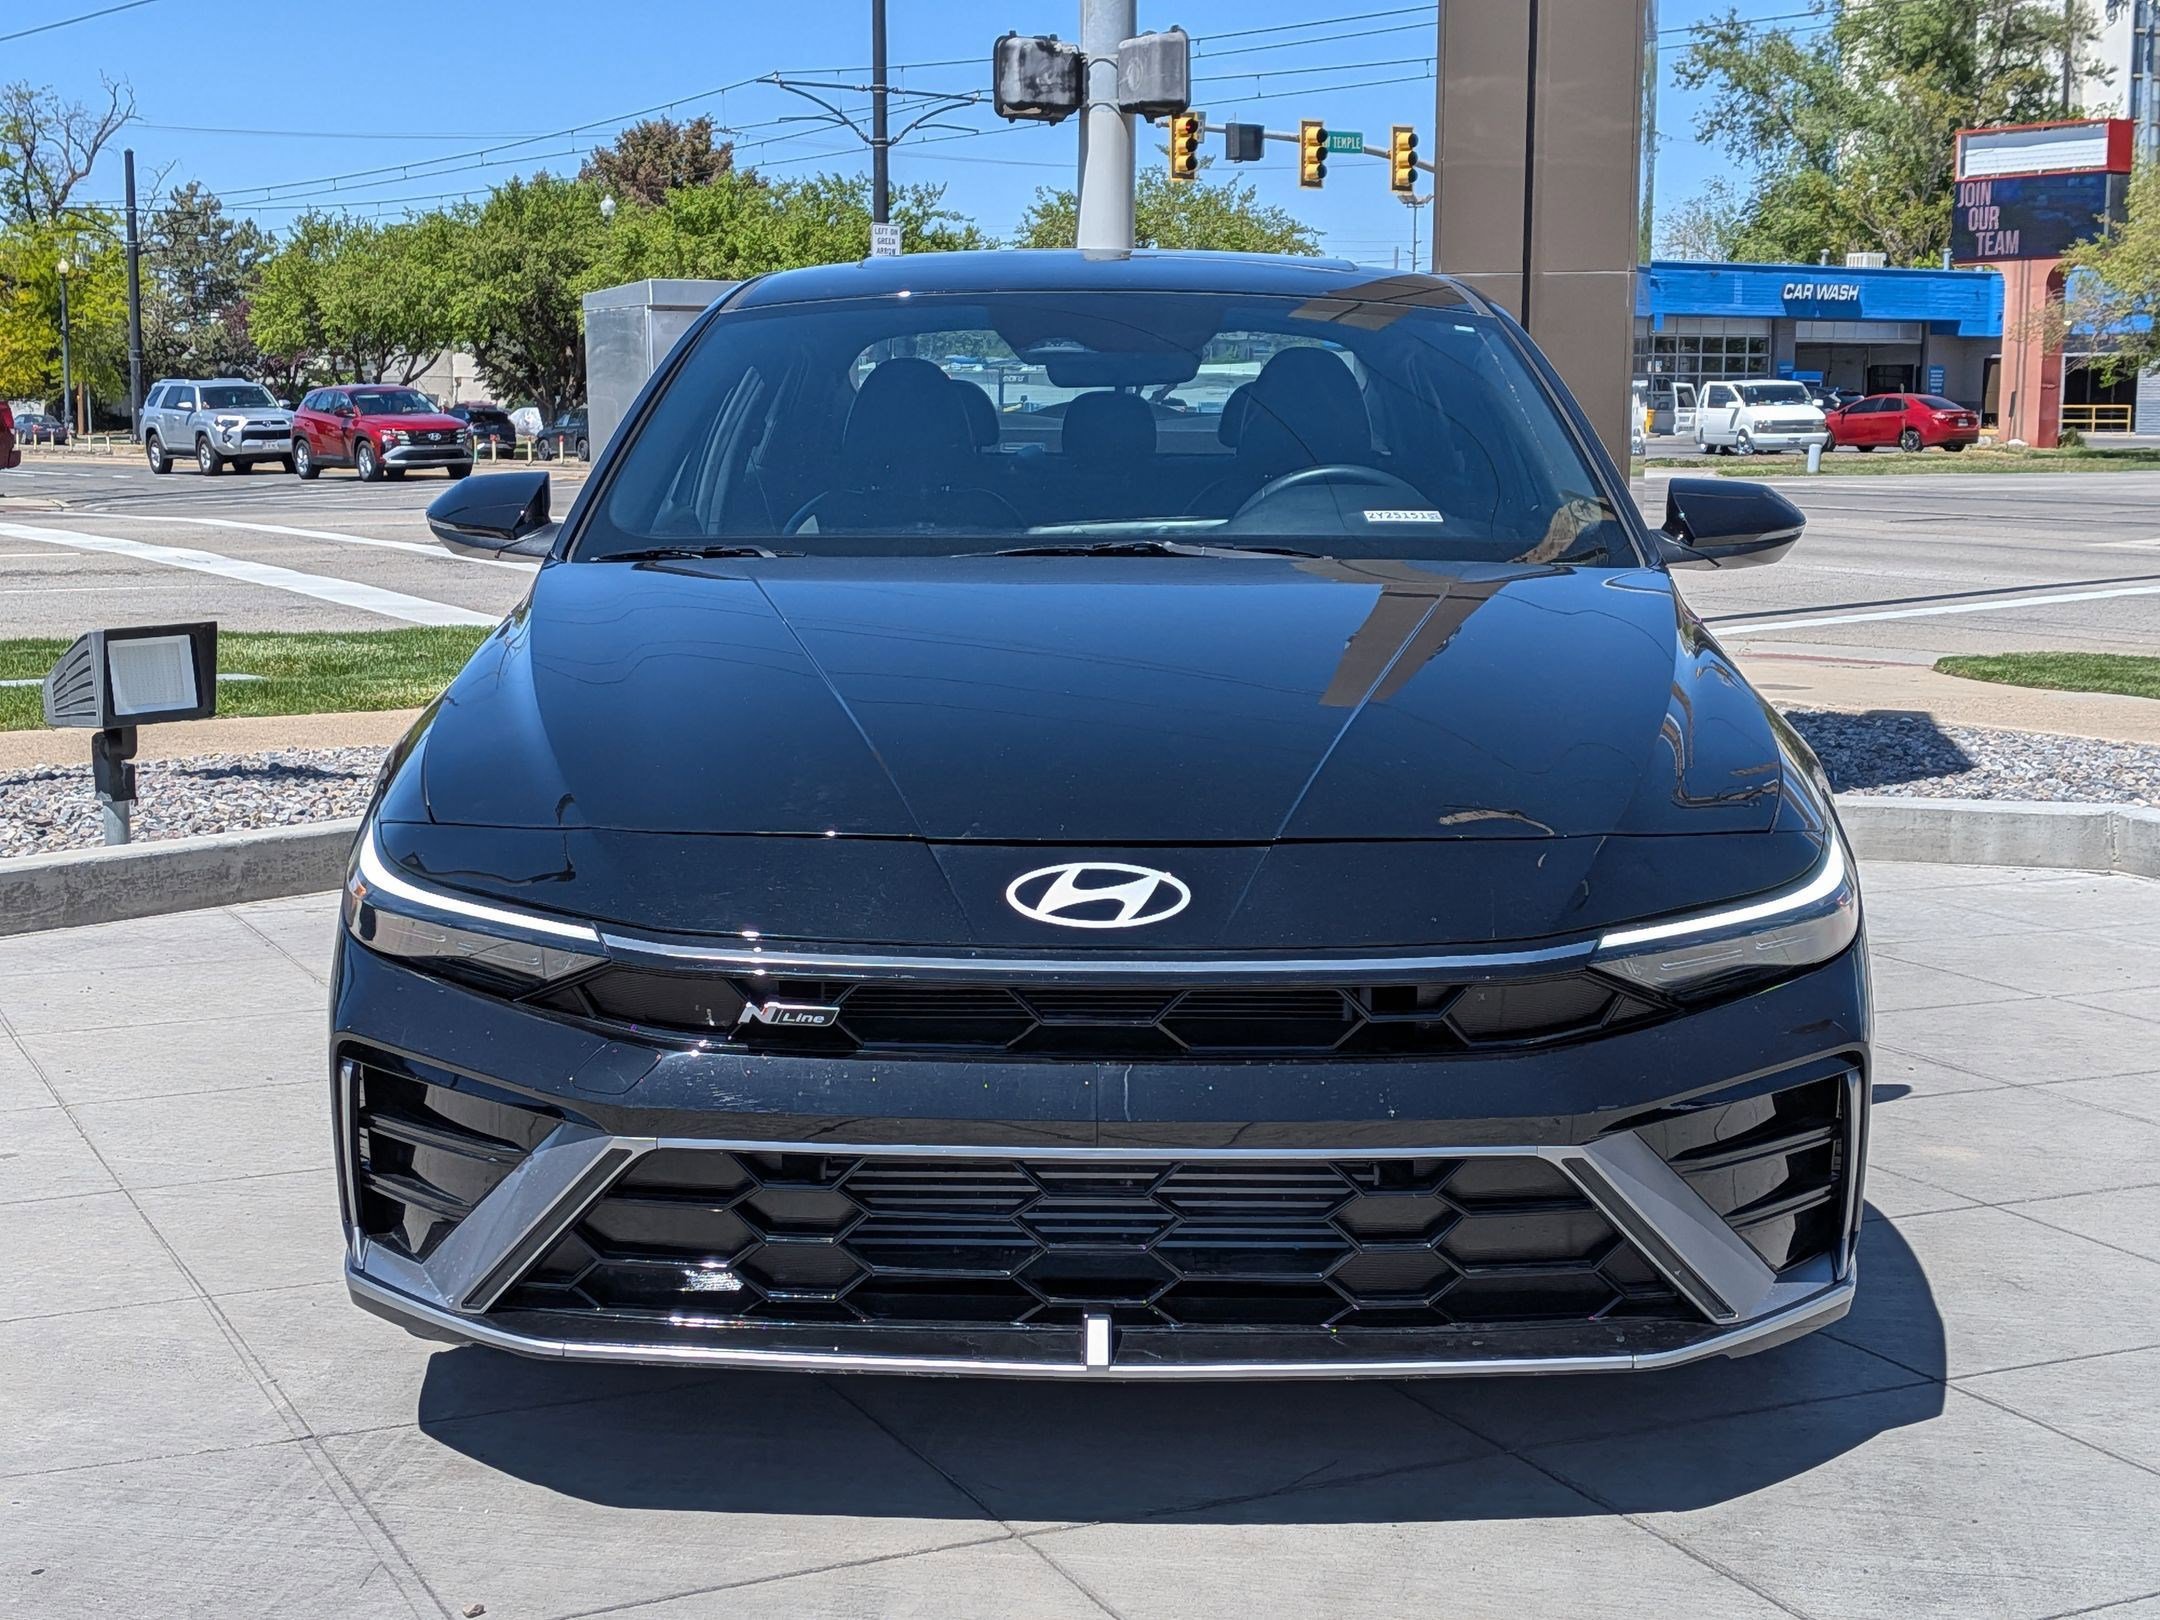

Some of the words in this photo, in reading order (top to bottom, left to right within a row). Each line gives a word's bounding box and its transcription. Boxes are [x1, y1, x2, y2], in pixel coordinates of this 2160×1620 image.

[1333, 136, 1361, 149] TEMPLE
[1957, 181, 1992, 207] JOIN
[1968, 206, 2000, 231] OUR
[874, 227, 888, 235] LEFT
[1976, 230, 2019, 256] TEAM
[1783, 283, 1813, 300] CAR
[1816, 284, 1860, 301] WASH
[782, 1012, 825, 1024] Line
